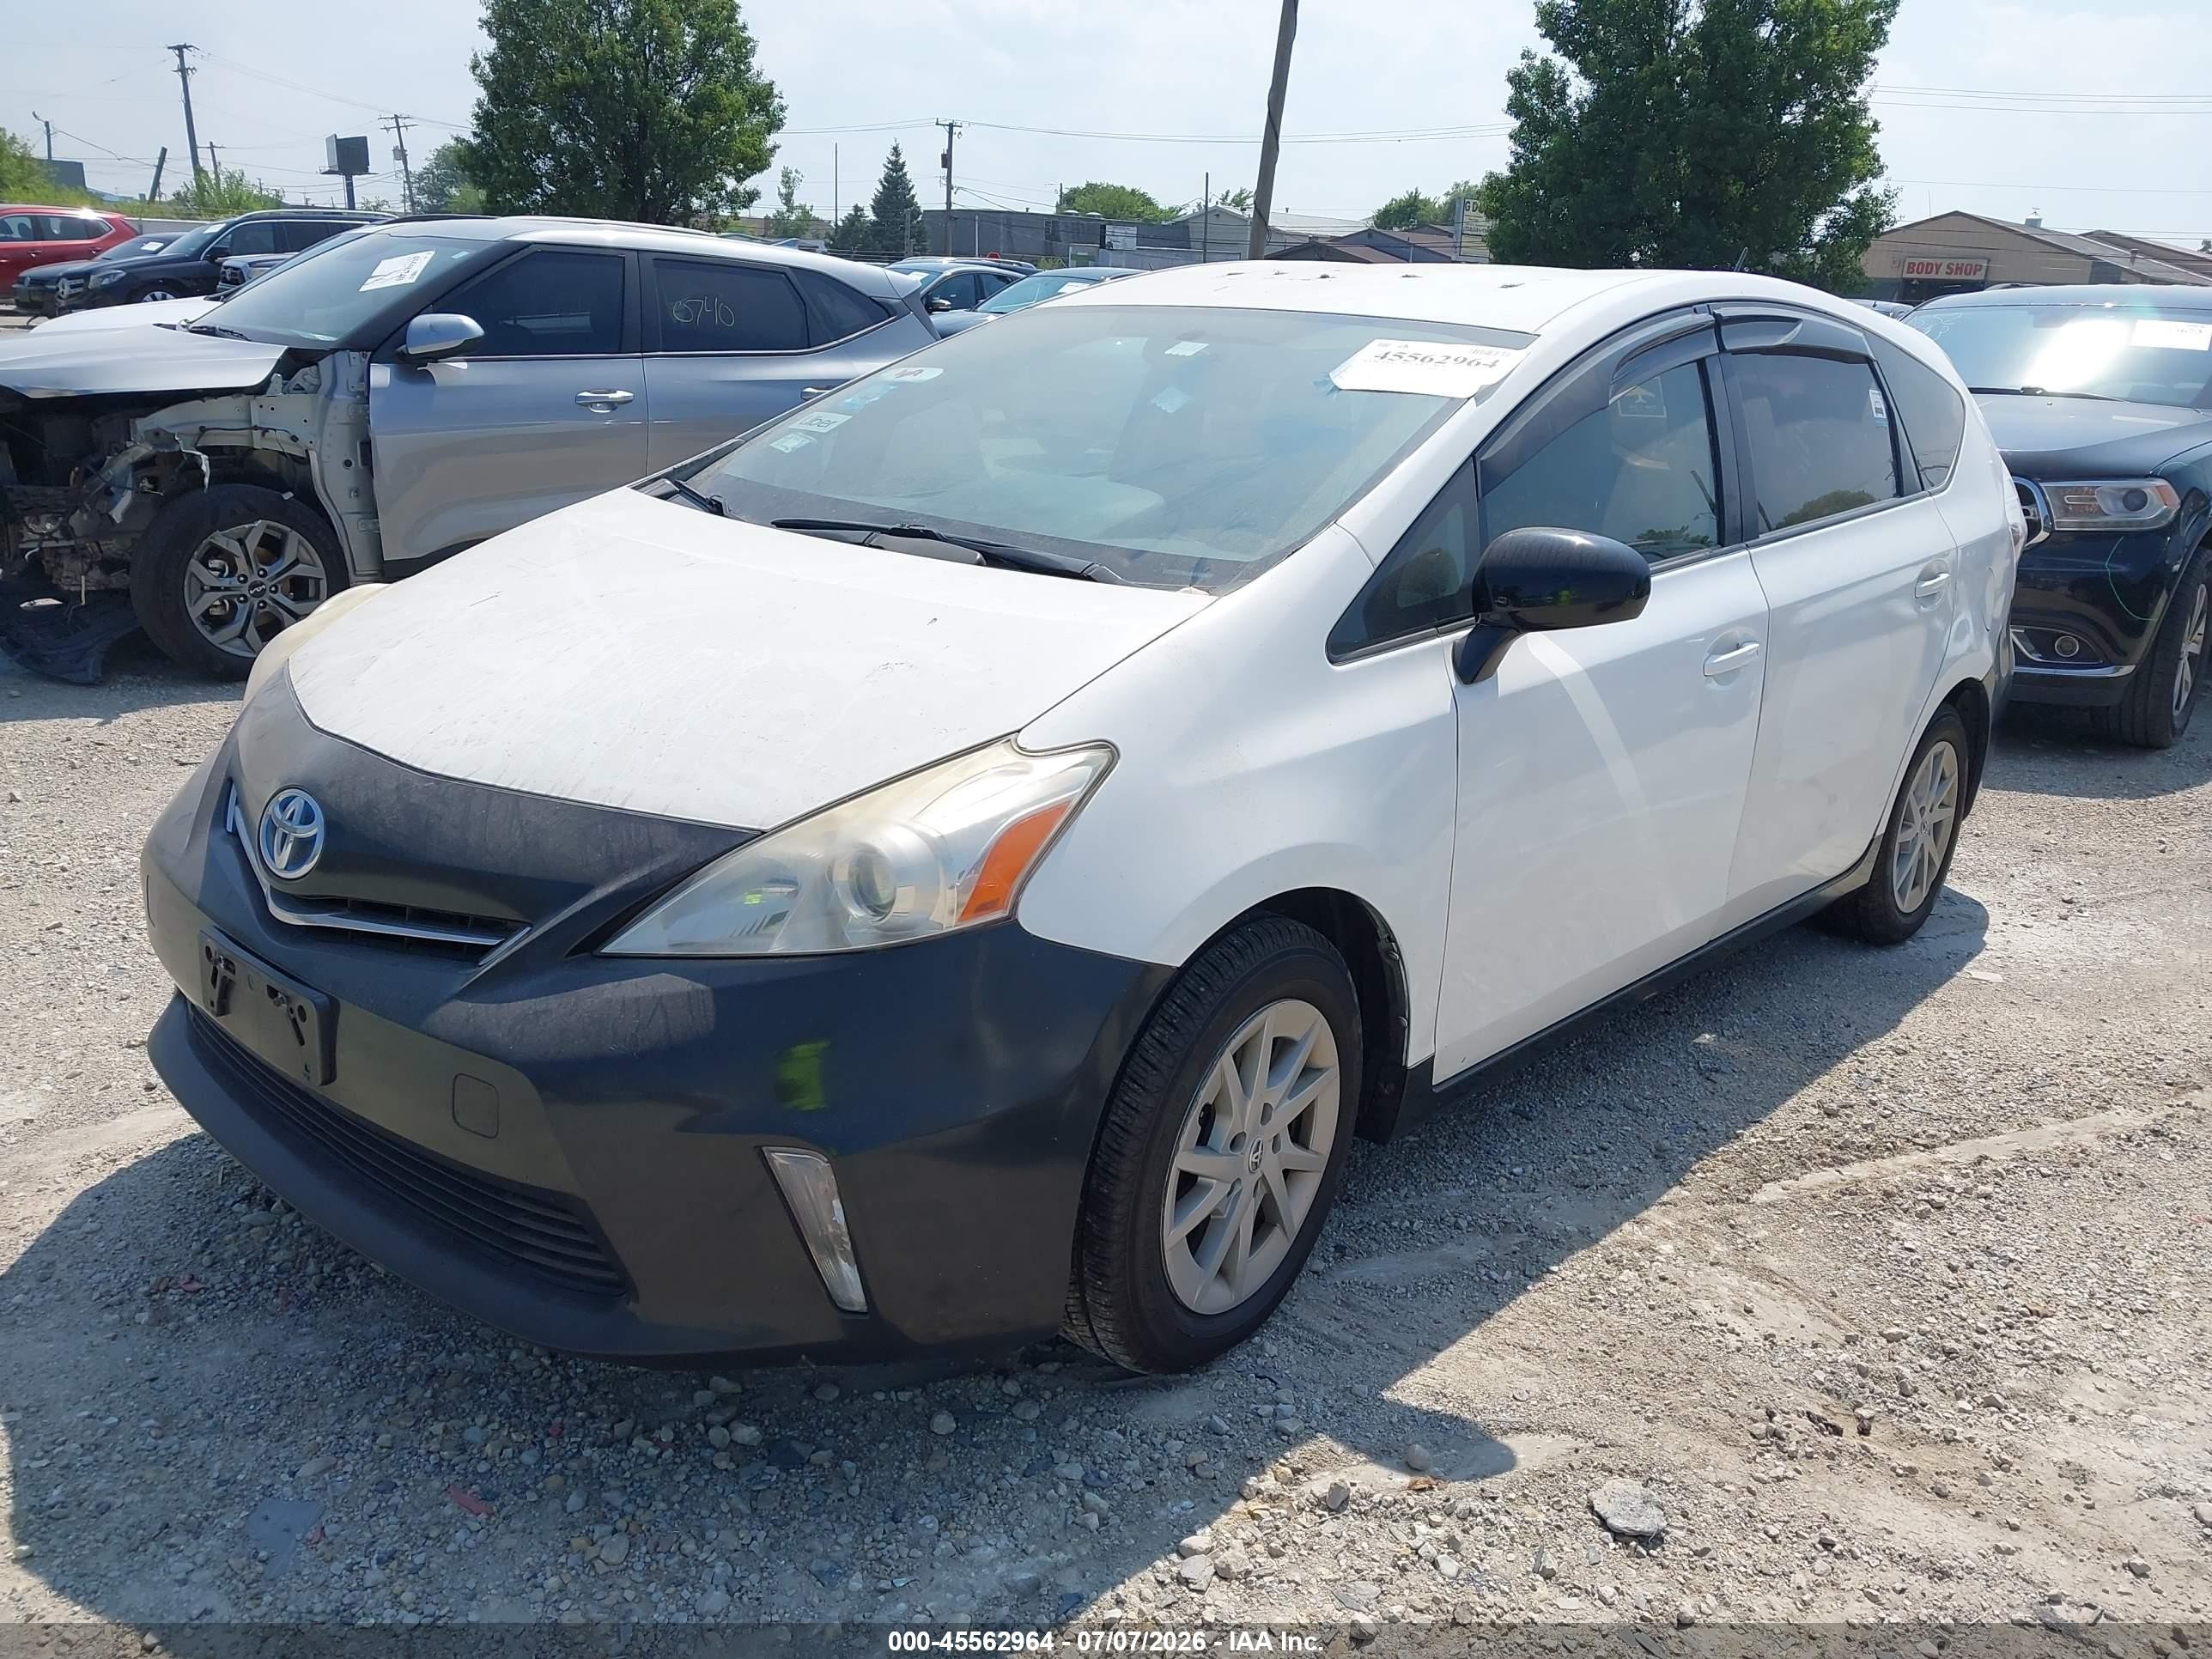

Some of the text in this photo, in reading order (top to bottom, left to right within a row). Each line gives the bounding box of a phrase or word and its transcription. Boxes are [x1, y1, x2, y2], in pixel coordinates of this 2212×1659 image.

[1907, 262, 1982, 276] BODY SHOP
[1374, 350, 1501, 369] 45562964
